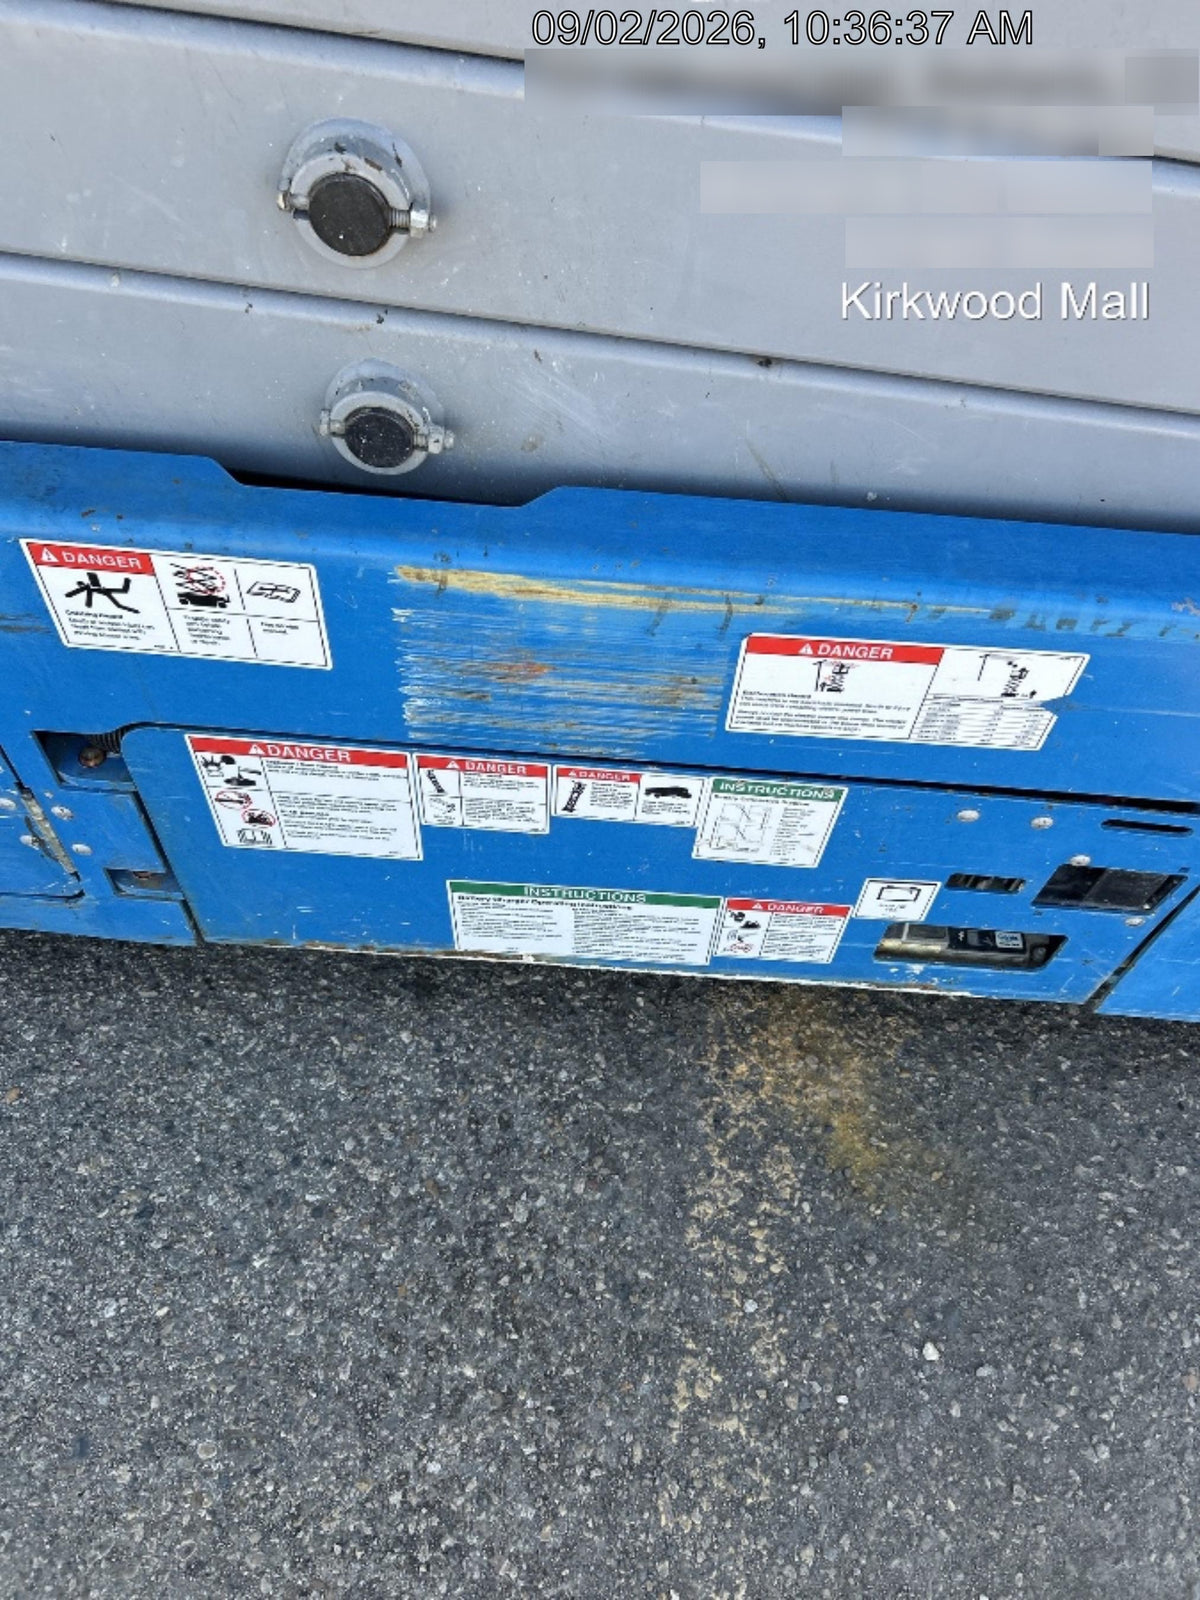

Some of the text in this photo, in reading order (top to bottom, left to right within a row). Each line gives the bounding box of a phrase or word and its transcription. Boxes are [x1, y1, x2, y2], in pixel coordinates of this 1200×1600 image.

[62, 550, 142, 570] DANGER
[817, 642, 893, 660] DANGER
[266, 744, 351, 762] DANGER
[465, 760, 527, 775] DANGER
[576, 770, 630, 781] DANGER
[719, 781, 836, 799] INSTRUCTIONS
[523, 886, 647, 903] INSTRUCTIONS
[767, 902, 824, 915] DANGER
